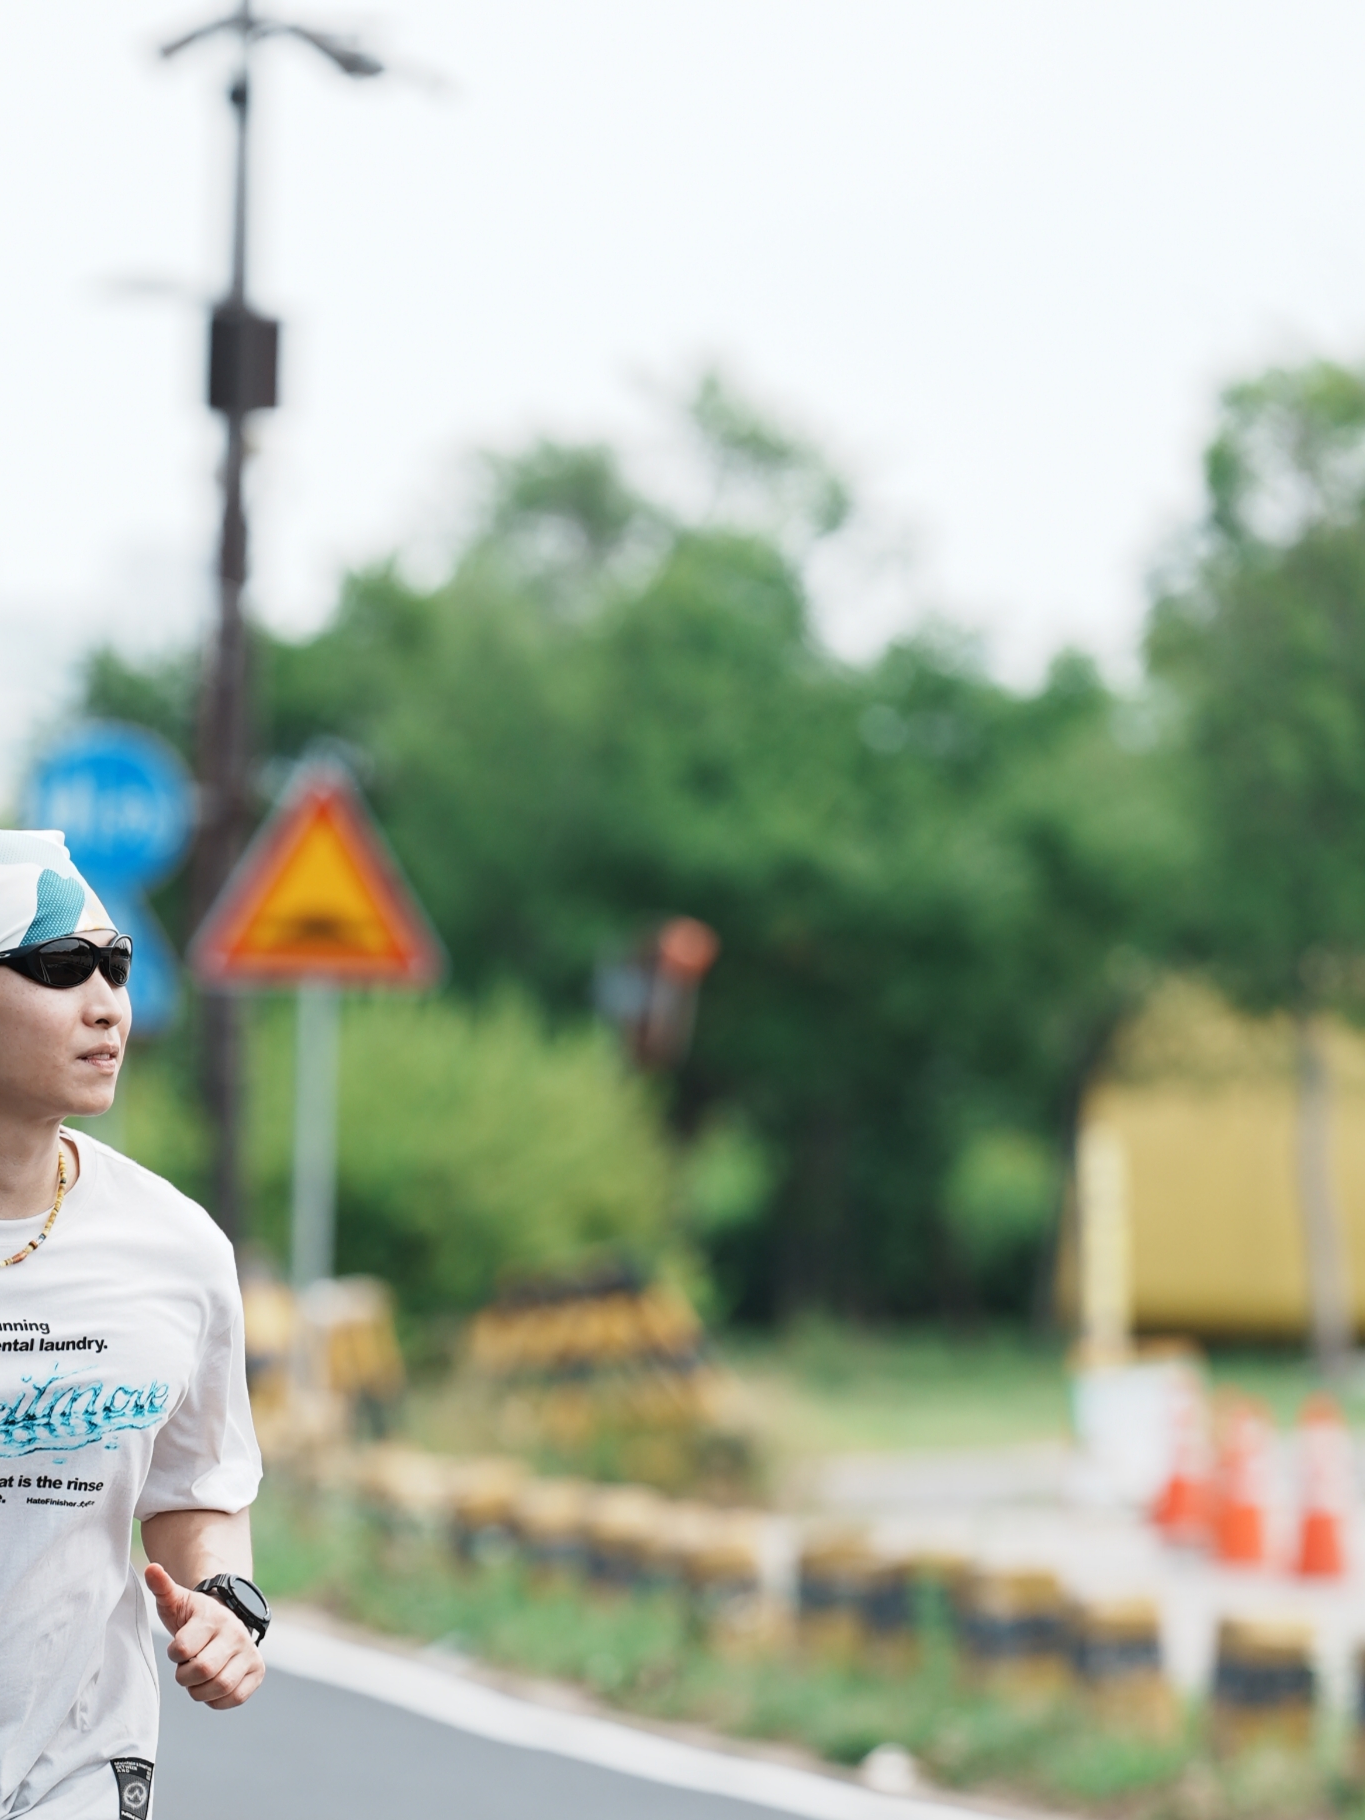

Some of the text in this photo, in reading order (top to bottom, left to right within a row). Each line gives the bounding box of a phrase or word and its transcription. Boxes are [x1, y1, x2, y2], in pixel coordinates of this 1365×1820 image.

[39, 1336, 108, 1353] laundry.
[17, 1474, 32, 1488] is
[36, 1475, 63, 1489] the
[66, 1477, 104, 1492] rinse
